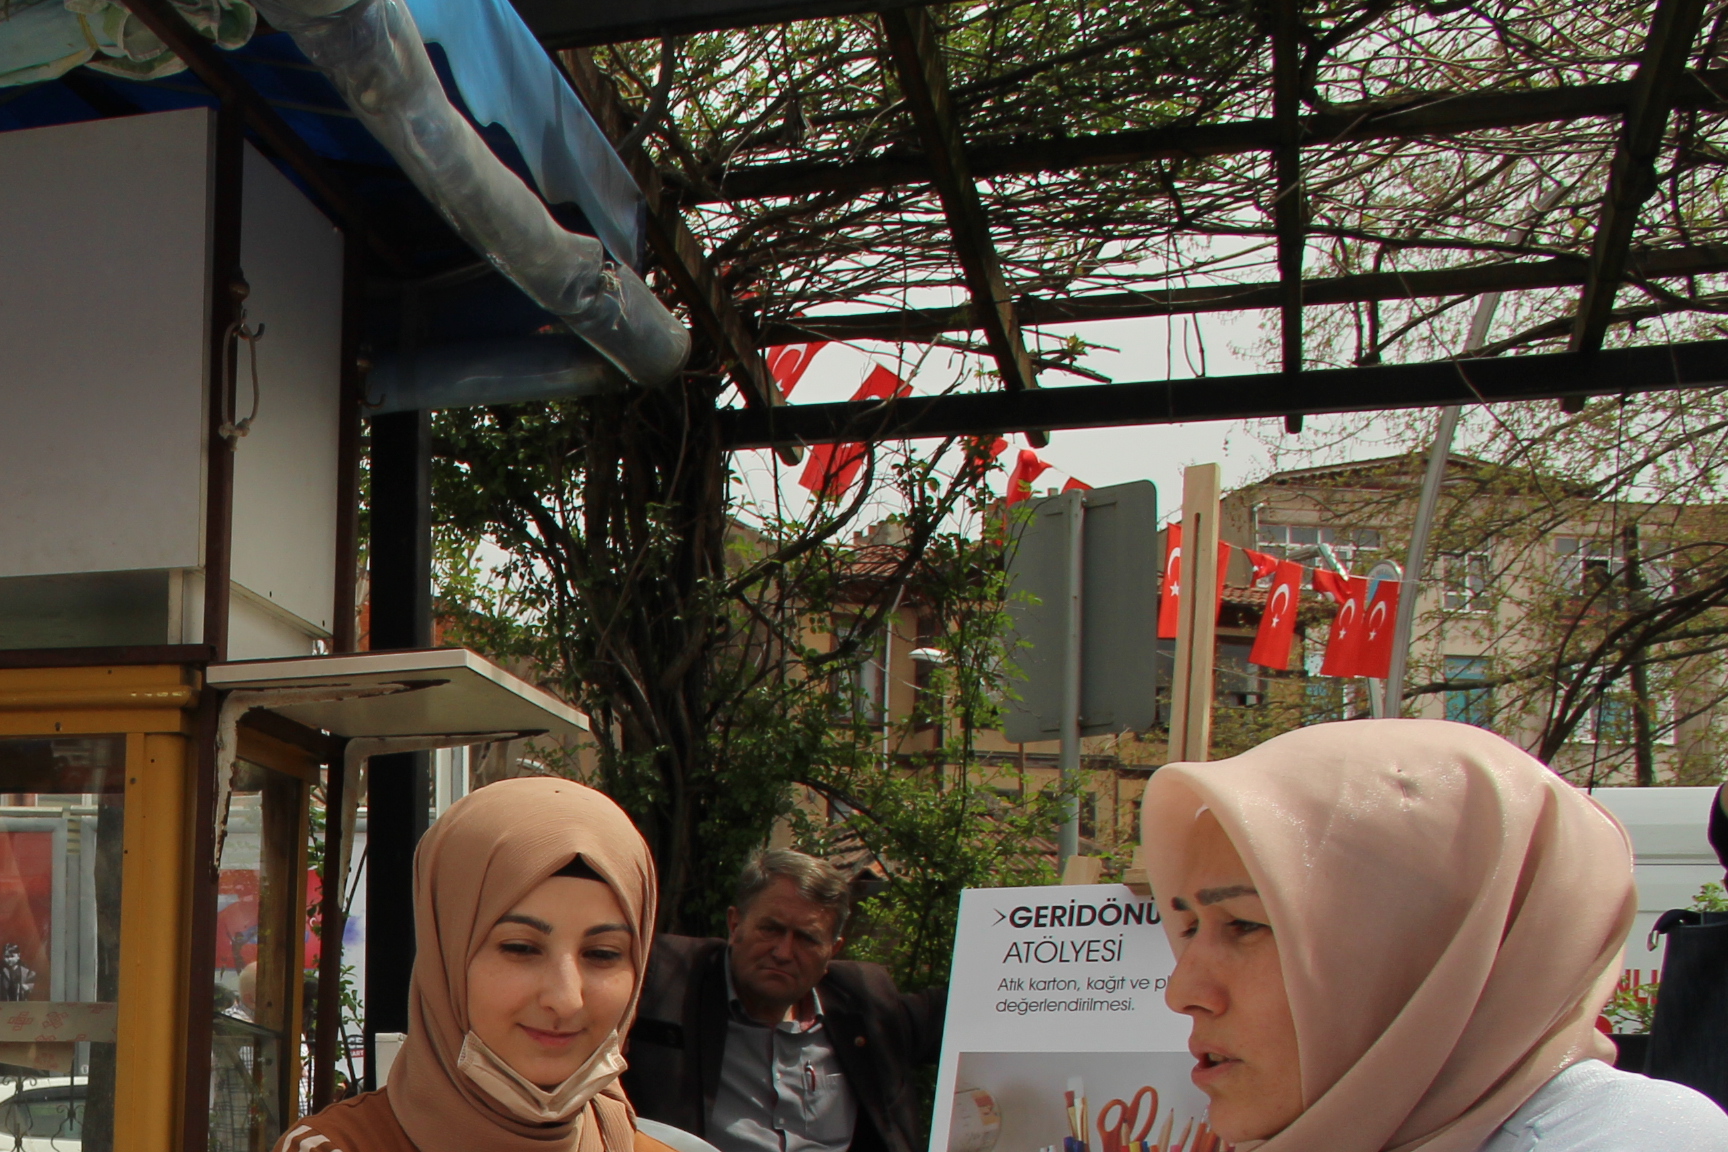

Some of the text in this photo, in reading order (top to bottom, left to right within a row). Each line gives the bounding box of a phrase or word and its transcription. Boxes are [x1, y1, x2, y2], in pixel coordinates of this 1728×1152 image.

[1008, 898, 1162, 929] GERİDÖNÜ
[1002, 933, 1124, 964] ATÖLYESİ
[997, 975, 1172, 994] Atık karton, kağıt ve pl
[995, 997, 1135, 1015] değerlendirilmesi.
